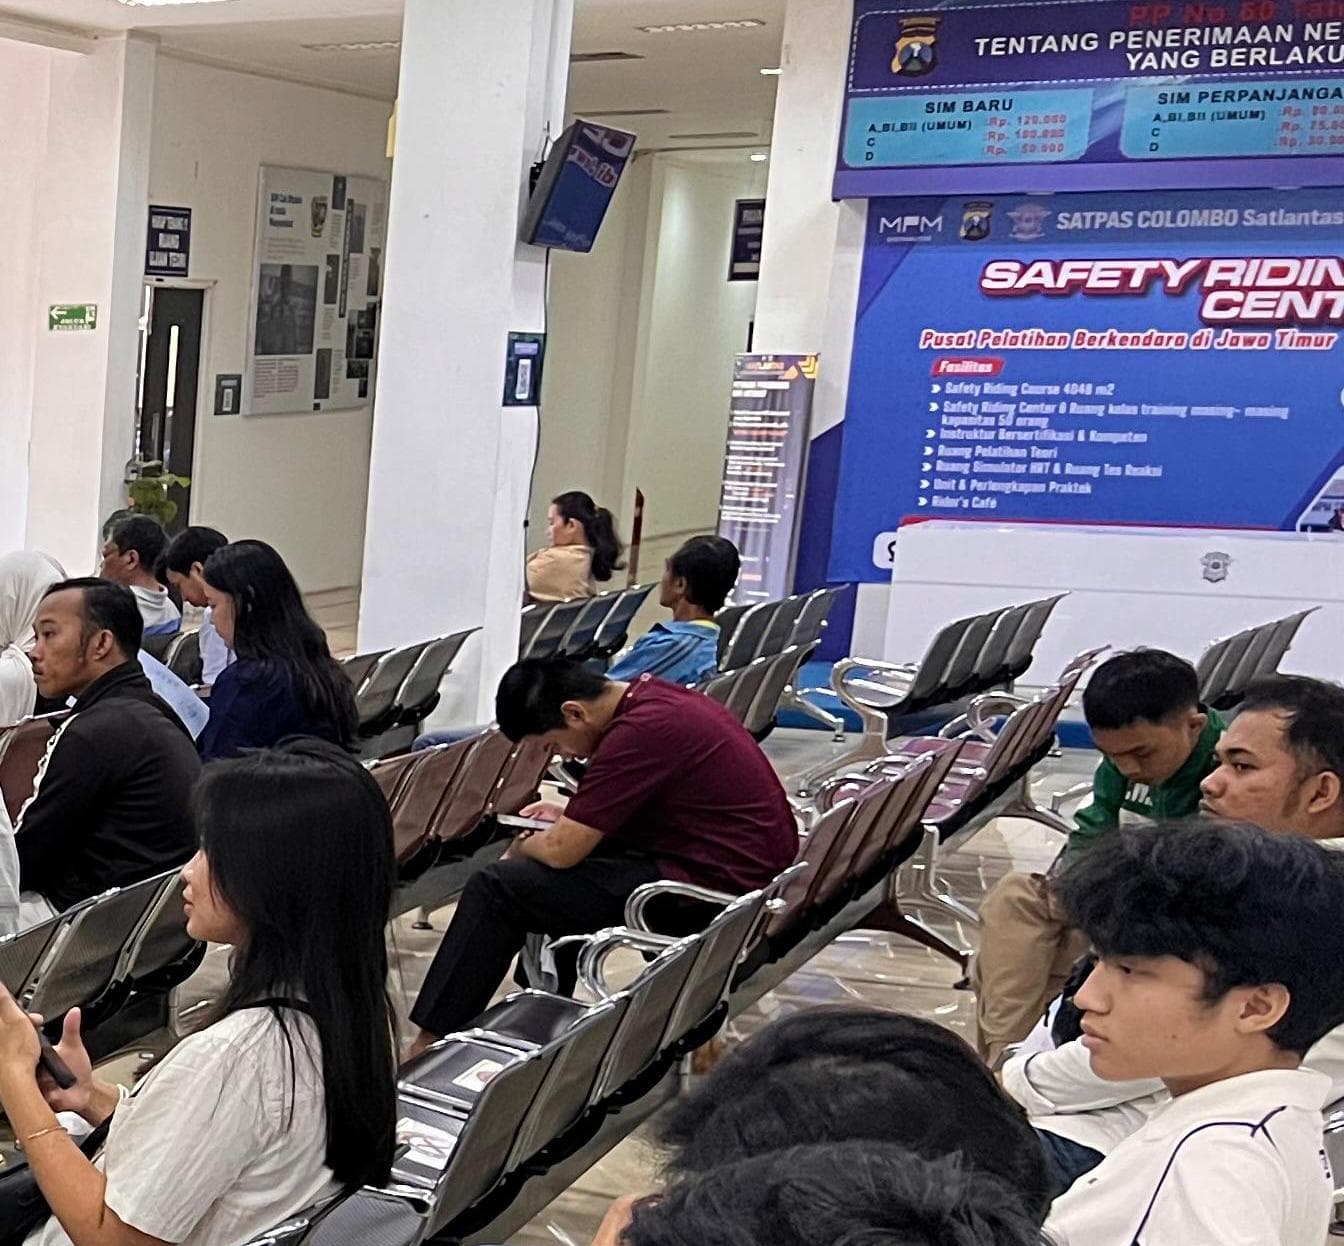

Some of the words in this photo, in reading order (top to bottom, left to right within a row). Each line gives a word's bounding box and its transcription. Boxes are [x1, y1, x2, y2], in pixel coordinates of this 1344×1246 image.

[975, 32, 1099, 56] TENTANG
[1108, 24, 1294, 50] PENERIMAAN
[1126, 50, 1201, 71] YANG
[1210, 45, 1344, 68] BERLAKU
[924, 101, 956, 114] SIM
[963, 98, 1014, 112] BARU
[1157, 91, 1191, 105] SIM
[1151, 127, 1161, 137] C
[866, 137, 876, 147] C
[1149, 142, 1160, 152] D
[865, 151, 874, 161] D
[879, 215, 943, 234] MPM
[1056, 210, 1134, 230] SATPAS
[1137, 208, 1239, 228] COLOMBO
[980, 258, 1202, 291] SAFETY
[920, 329, 976, 349] Pusat
[977, 329, 1071, 349] Pelatihan
[1071, 329, 1189, 349] Berkendara
[1190, 328, 1213, 348] di
[1214, 328, 1271, 349] Jawa
[1275, 328, 1338, 349] Timur
